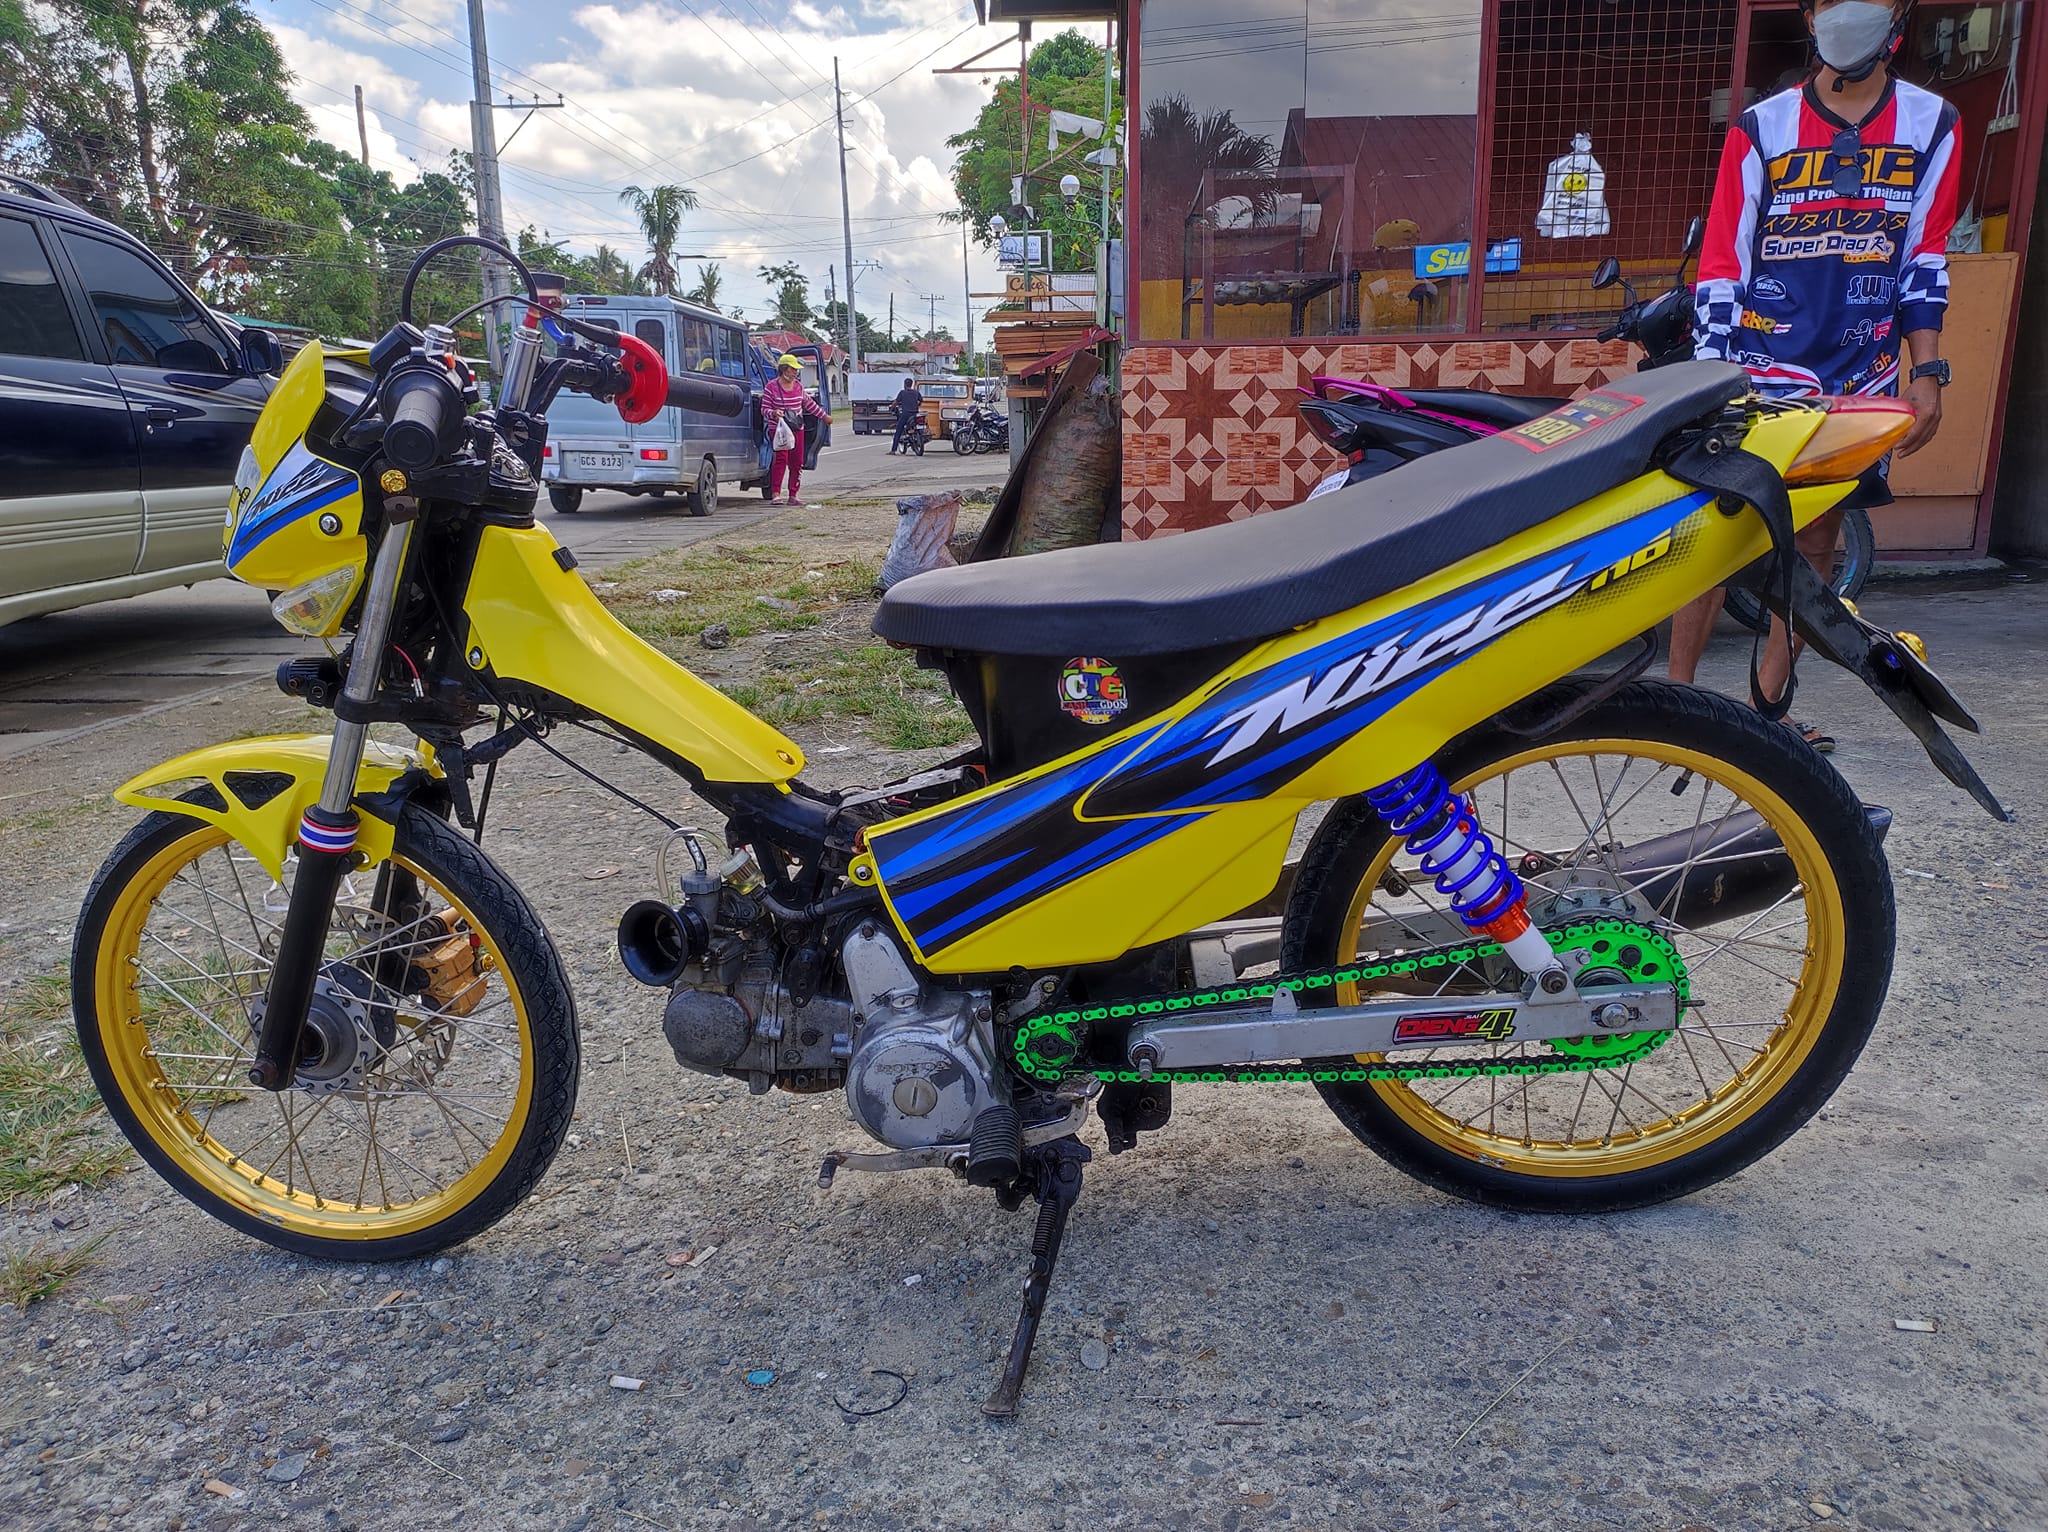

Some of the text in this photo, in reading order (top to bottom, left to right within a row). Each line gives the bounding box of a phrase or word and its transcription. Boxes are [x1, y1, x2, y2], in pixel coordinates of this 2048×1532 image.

[1765, 239, 1823, 256] Super
[1825, 236, 1869, 254] Drag
[581, 456, 622, 467] GCS 8173
[1400, 1018, 1479, 1036] DAENG
[1477, 1009, 1515, 1040] 4
